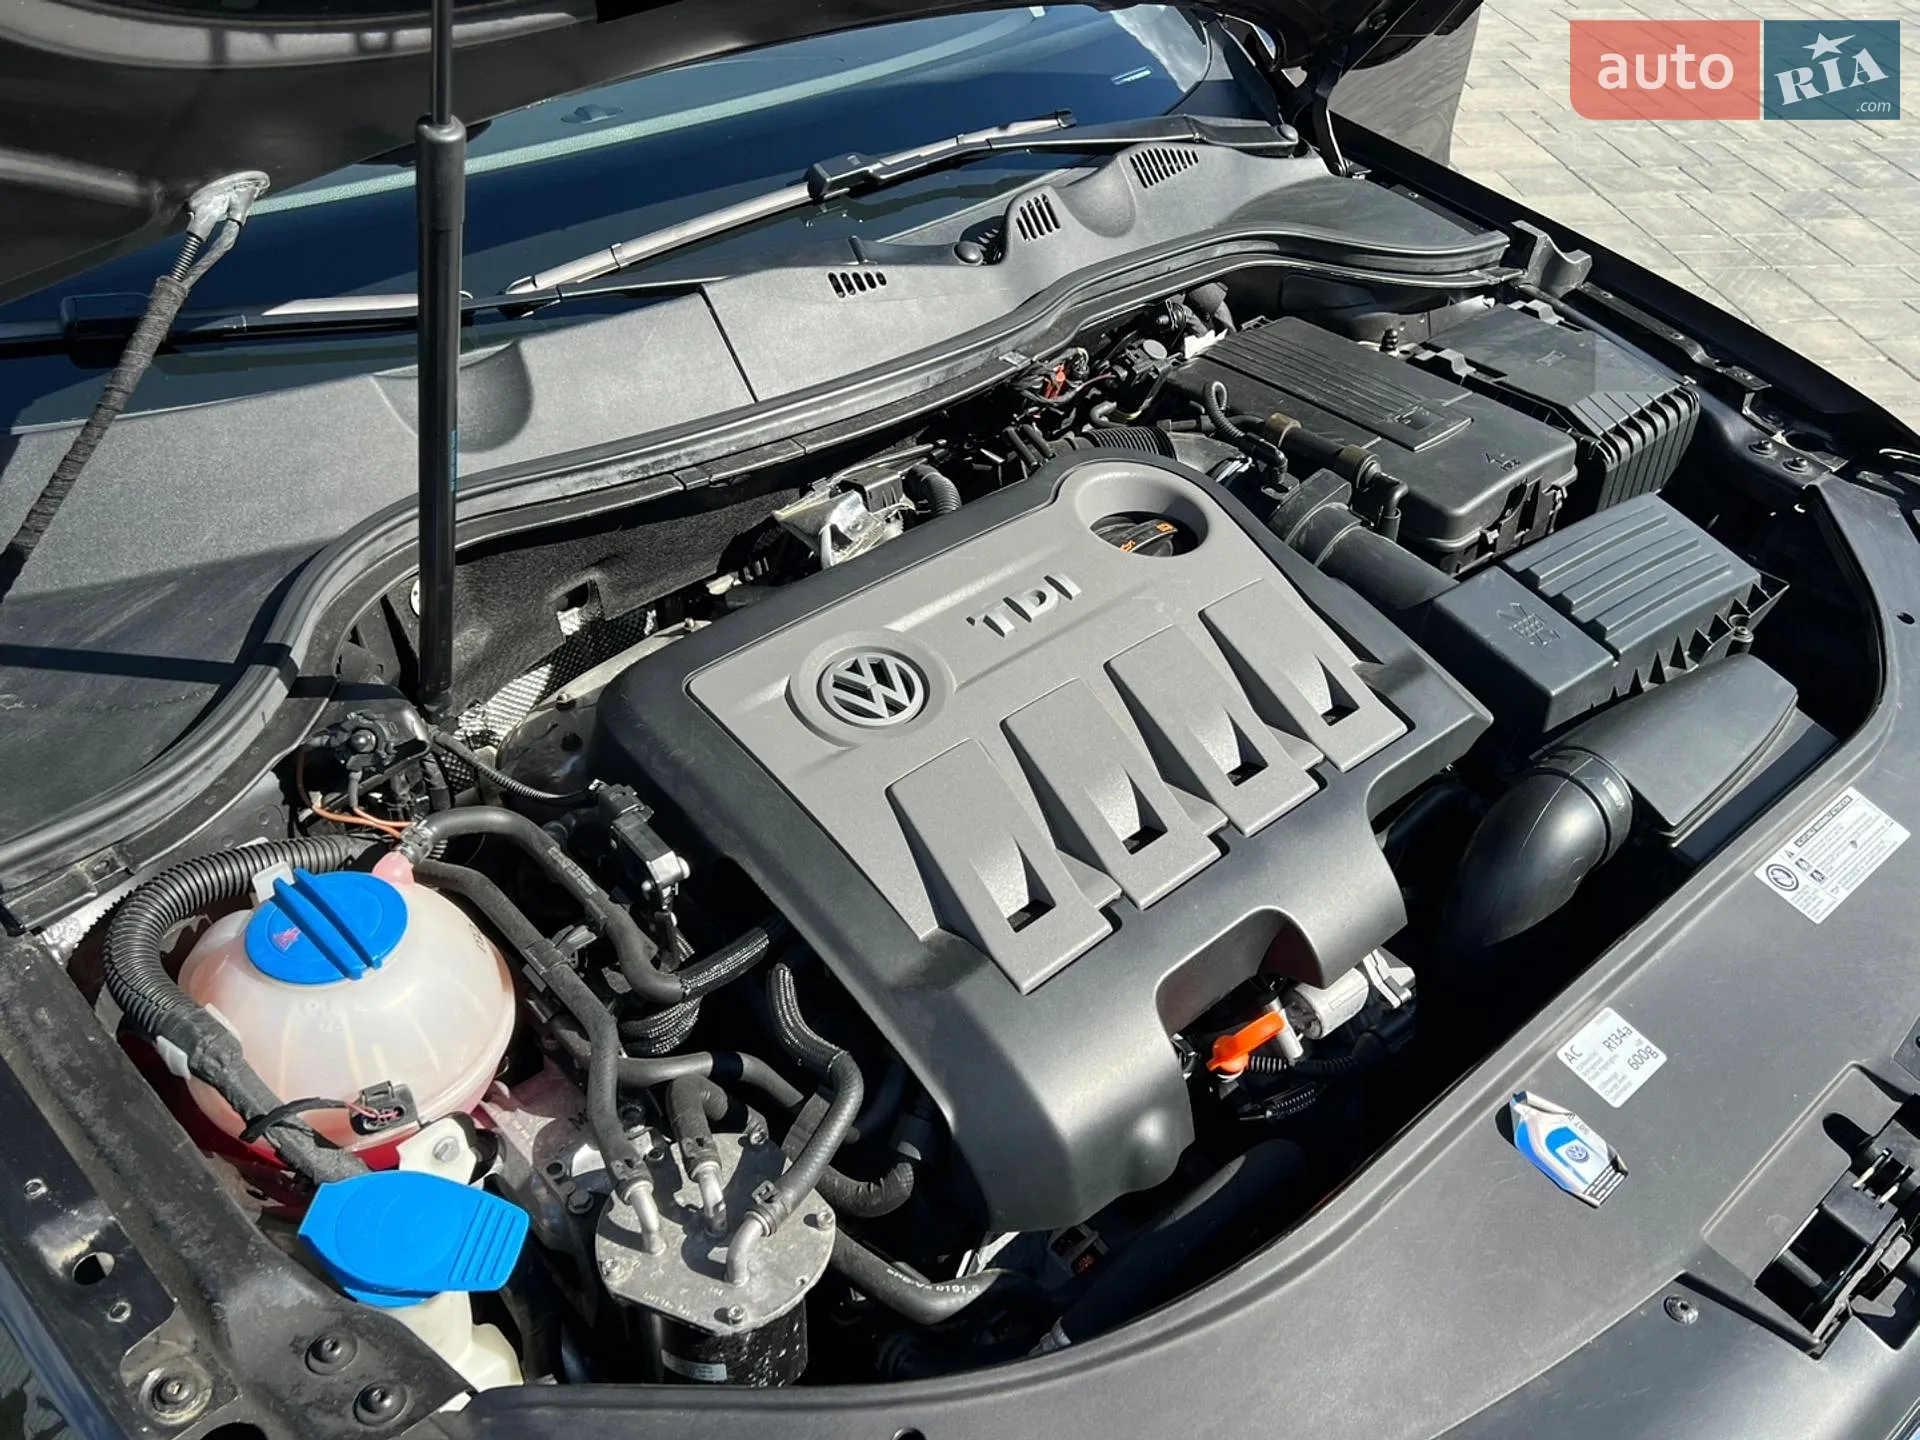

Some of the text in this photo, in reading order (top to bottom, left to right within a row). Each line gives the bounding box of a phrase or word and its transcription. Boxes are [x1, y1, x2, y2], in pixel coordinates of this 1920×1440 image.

[966, 574, 1082, 638] TDI
[825, 654, 928, 727] VW
[1602, 1026, 1633, 1052] R134a
[1564, 1045, 1583, 1064] AC
[1627, 1045, 1660, 1071] 600g
